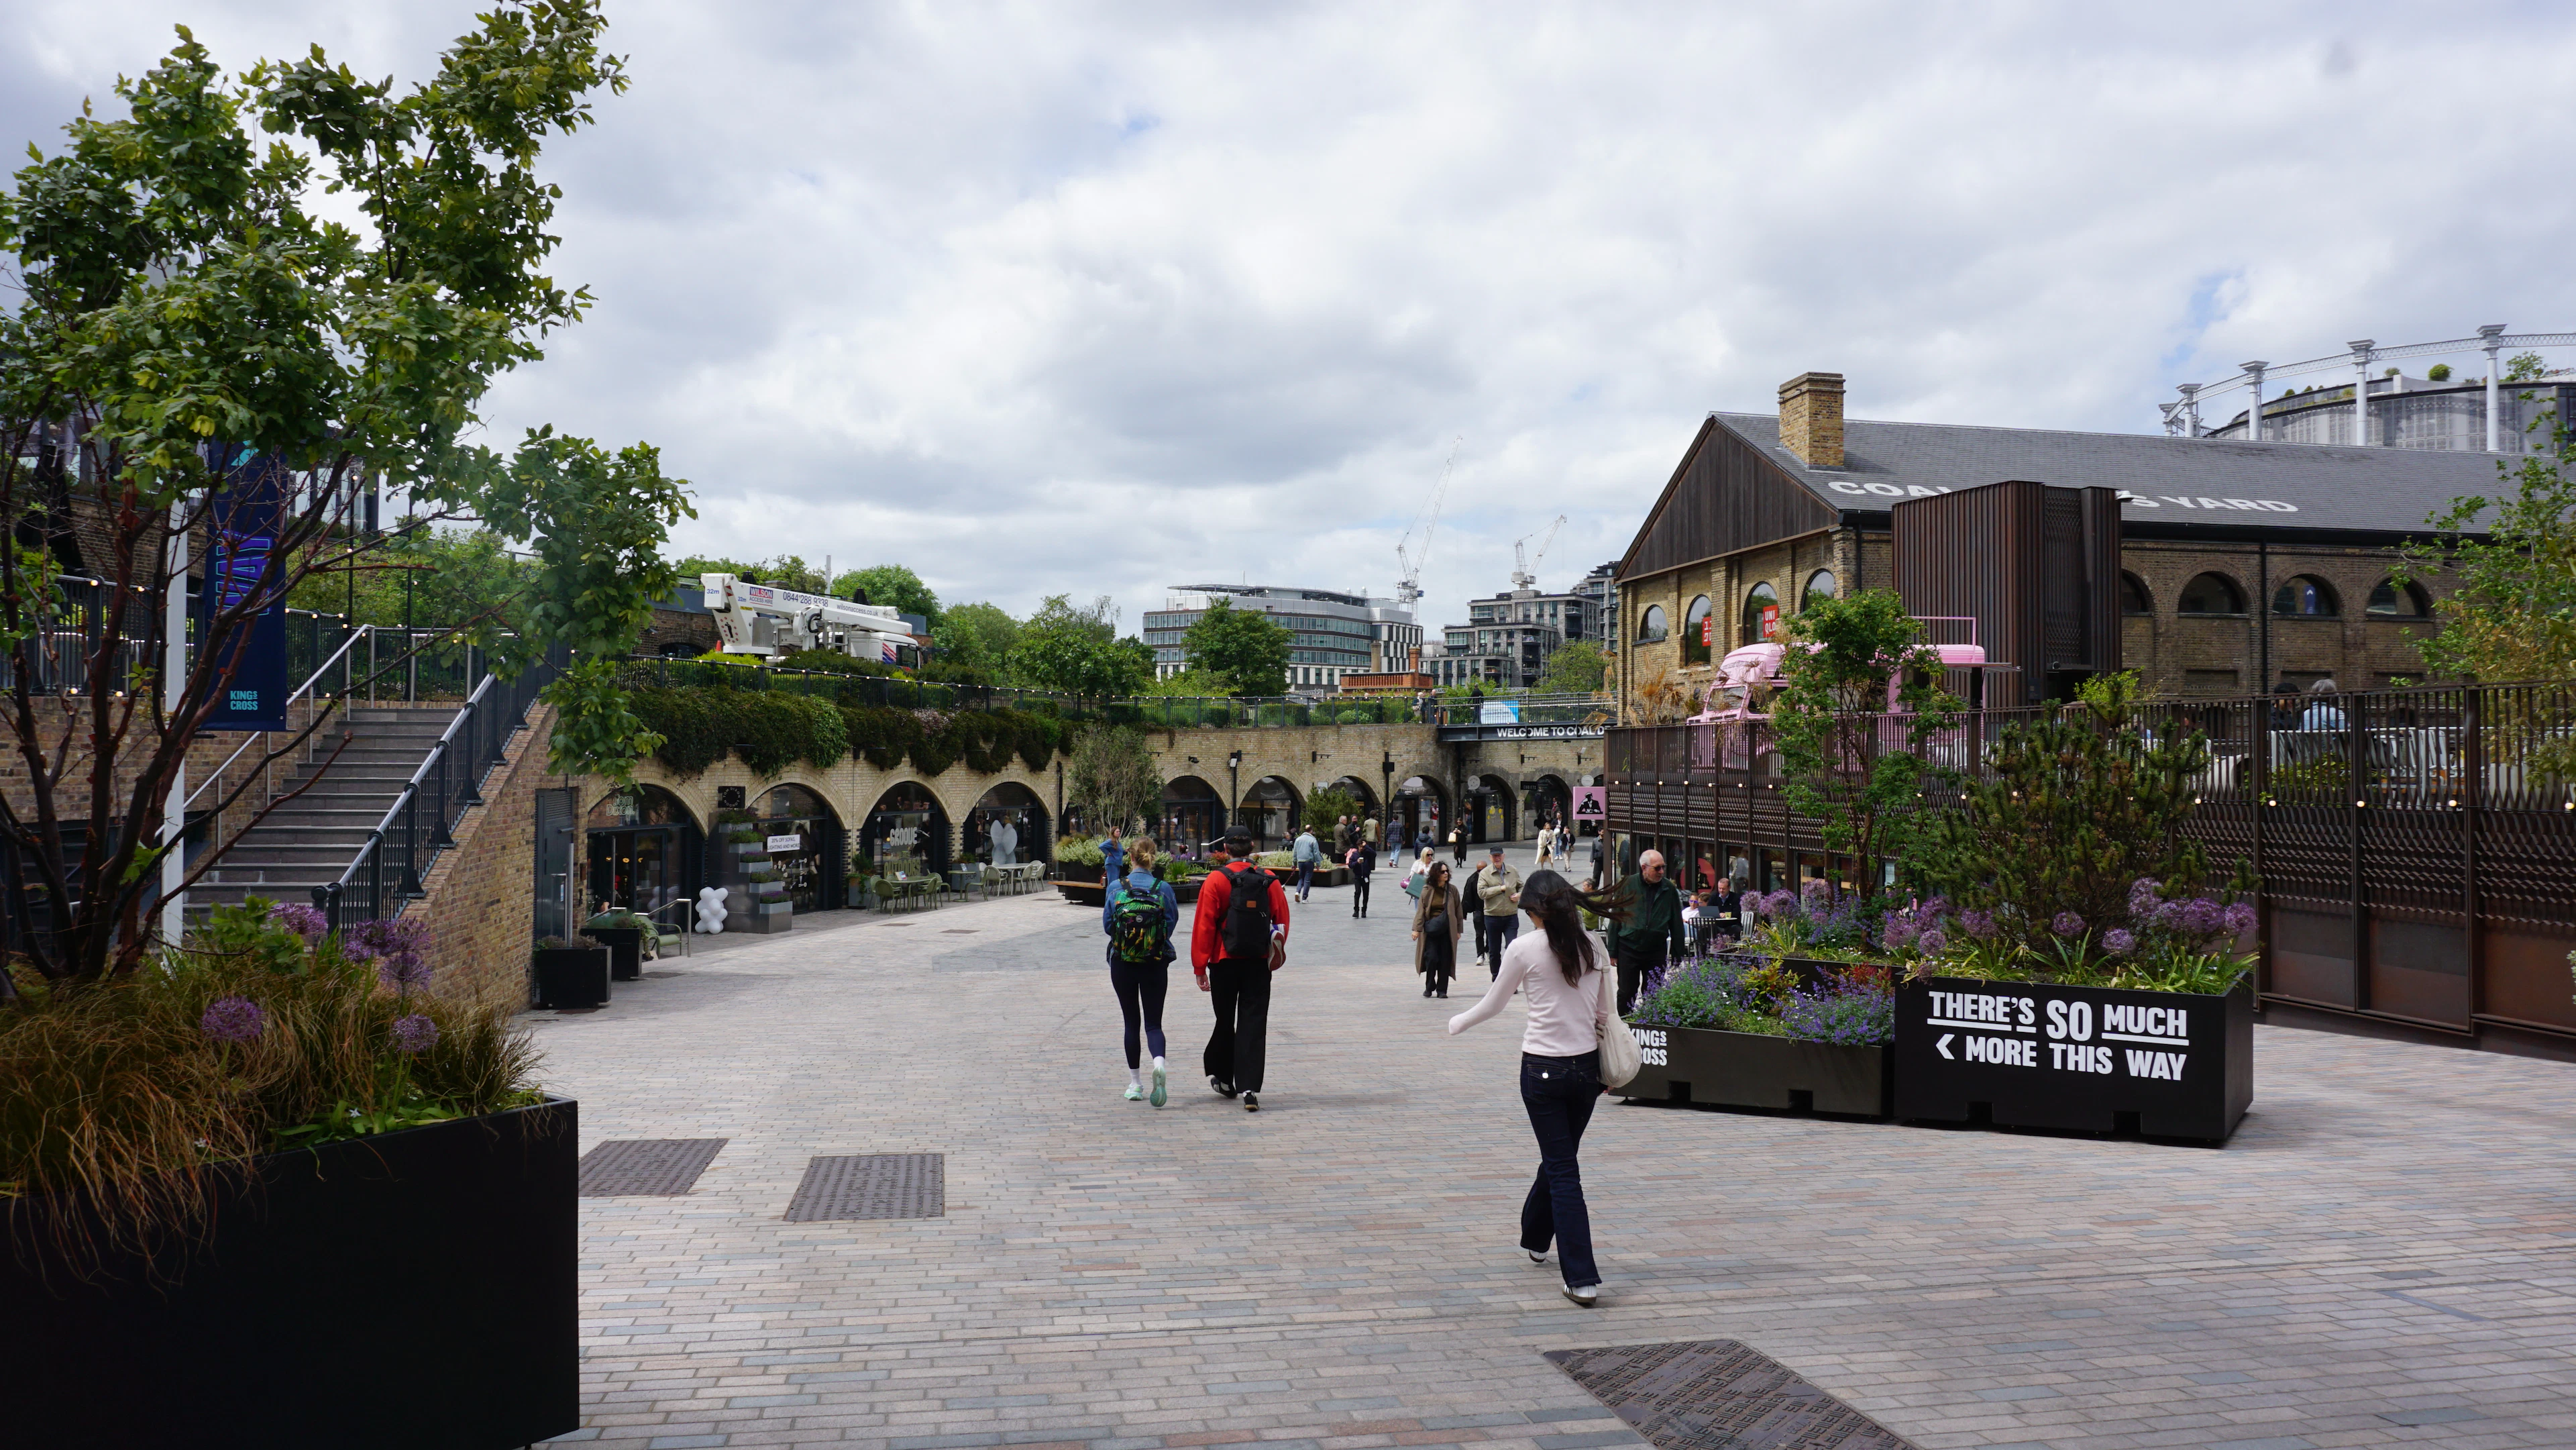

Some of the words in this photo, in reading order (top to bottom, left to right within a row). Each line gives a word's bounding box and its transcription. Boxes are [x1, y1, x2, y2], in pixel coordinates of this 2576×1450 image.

[1828, 481, 1951, 497] COA
[2158, 496, 2298, 512] YARD
[750, 586, 773, 599] WILSON
[783, 592, 799, 603] 0844
[800, 594, 812, 605] 288
[837, 604, 879, 616] wilsonaccess.co.uk
[1764, 610, 1776, 621] UNI
[1764, 621, 1776, 634] QLO
[230, 701, 258, 711] CROSS
[1497, 727, 1550, 737] WELCOME
[1550, 726, 1565, 736] TO
[1566, 726, 1595, 735] COAL
[613, 794, 634, 807] Tom
[1927, 991, 2036, 1027] THERE'S
[2046, 999, 2092, 1041] SO
[2103, 1003, 2188, 1039] MUCH
[1641, 1047, 1668, 1066] OSS
[1966, 1035, 2037, 1068] MORE
[2049, 1043, 2113, 1074] THIS
[2125, 1049, 2188, 1081] WAY
